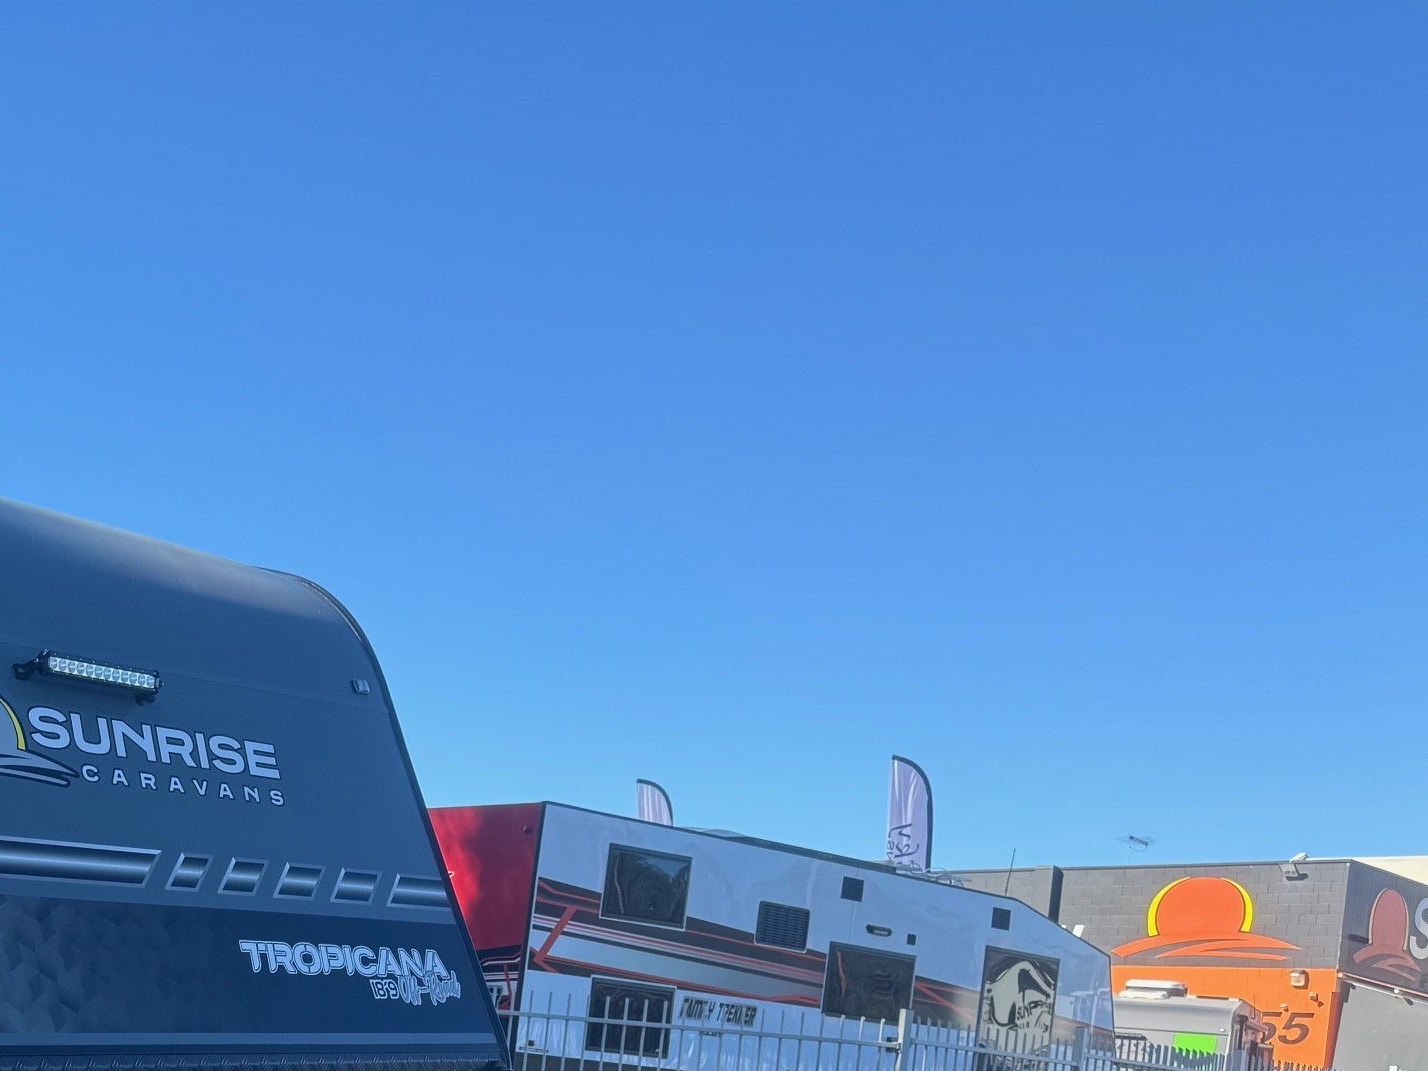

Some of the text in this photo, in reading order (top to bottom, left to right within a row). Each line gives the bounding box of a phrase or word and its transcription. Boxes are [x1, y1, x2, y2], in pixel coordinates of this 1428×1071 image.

[27, 706, 281, 780] SUNRISE
[81, 765, 285, 806] CARAVANS
[238, 939, 450, 979] TROPICANA
